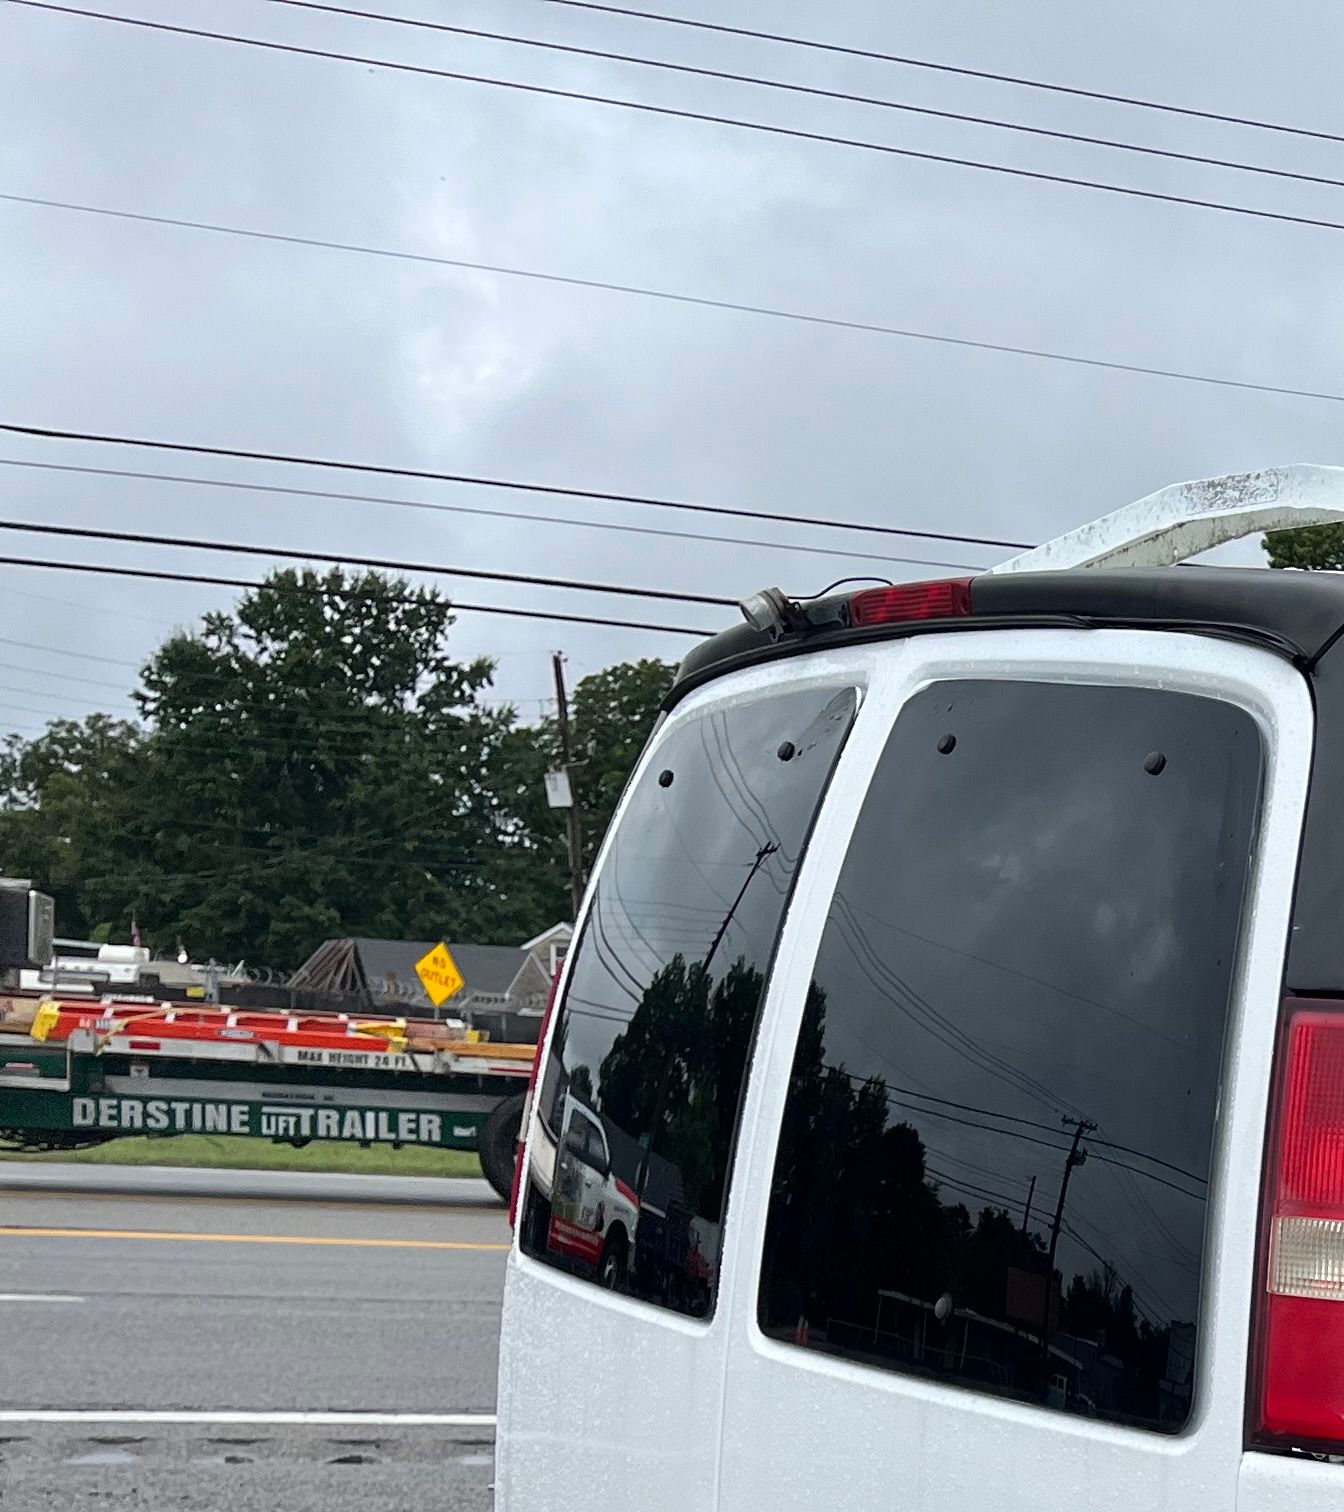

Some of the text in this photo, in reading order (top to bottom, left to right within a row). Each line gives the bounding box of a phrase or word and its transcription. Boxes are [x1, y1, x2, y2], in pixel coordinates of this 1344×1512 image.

[421, 967, 456, 988] OUTLET
[297, 1050, 323, 1063] MAX
[328, 1052, 369, 1067] HEIGHT
[374, 1055, 391, 1067] 24
[72, 1097, 442, 1142] DERSTINE LIFT TRAILER
